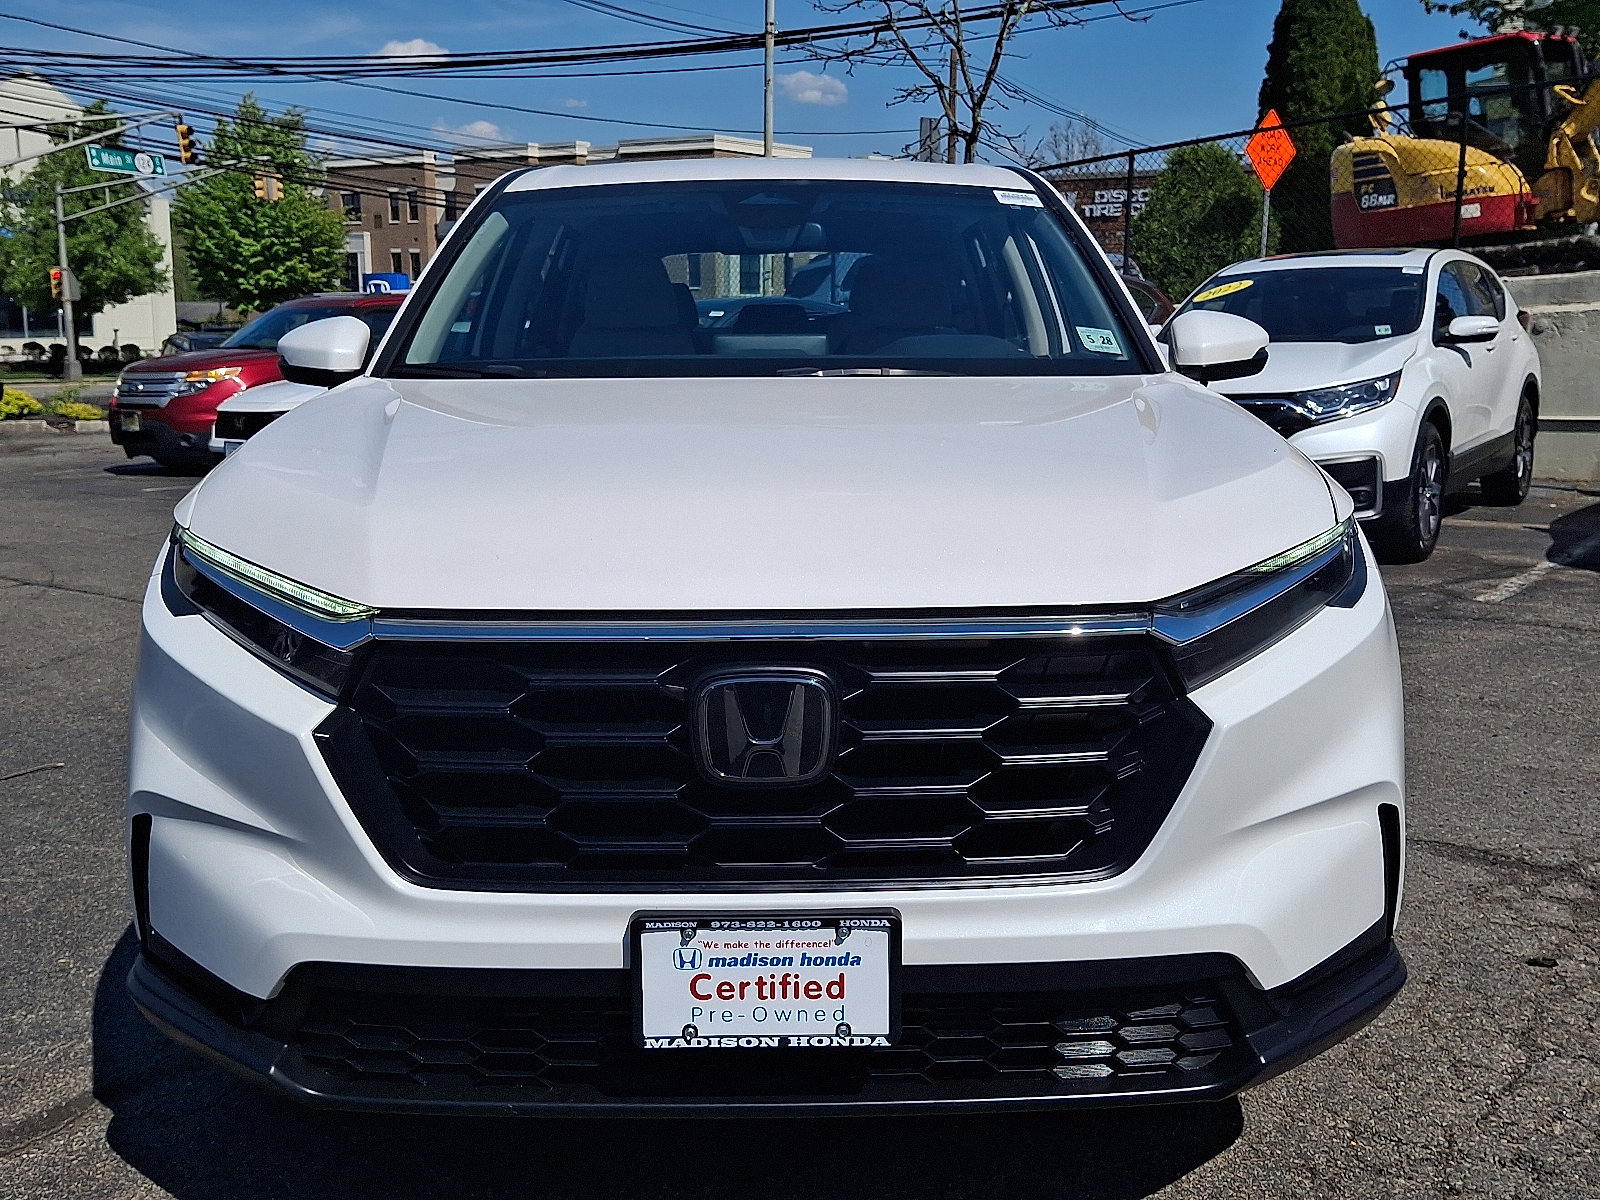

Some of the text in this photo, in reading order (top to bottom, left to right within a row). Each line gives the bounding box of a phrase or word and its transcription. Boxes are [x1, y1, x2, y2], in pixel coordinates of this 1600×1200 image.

[100, 152, 123, 166] Main
[1094, 188, 1150, 203] DISCO
[1081, 203, 1123, 217] TIRE
[1201, 281, 1245, 299] 2022
[1086, 334, 1114, 346] 5 28
[645, 919, 892, 929] MADISON 973-822-1600 HONDA
[723, 940, 749, 949] make
[753, 940, 771, 949] the
[707, 952, 794, 968] madison
[798, 951, 863, 967] honda
[689, 973, 846, 1001] Certified
[690, 1004, 846, 1023] Pre-Owned
[643, 1035, 892, 1049] MADISON HONDA
